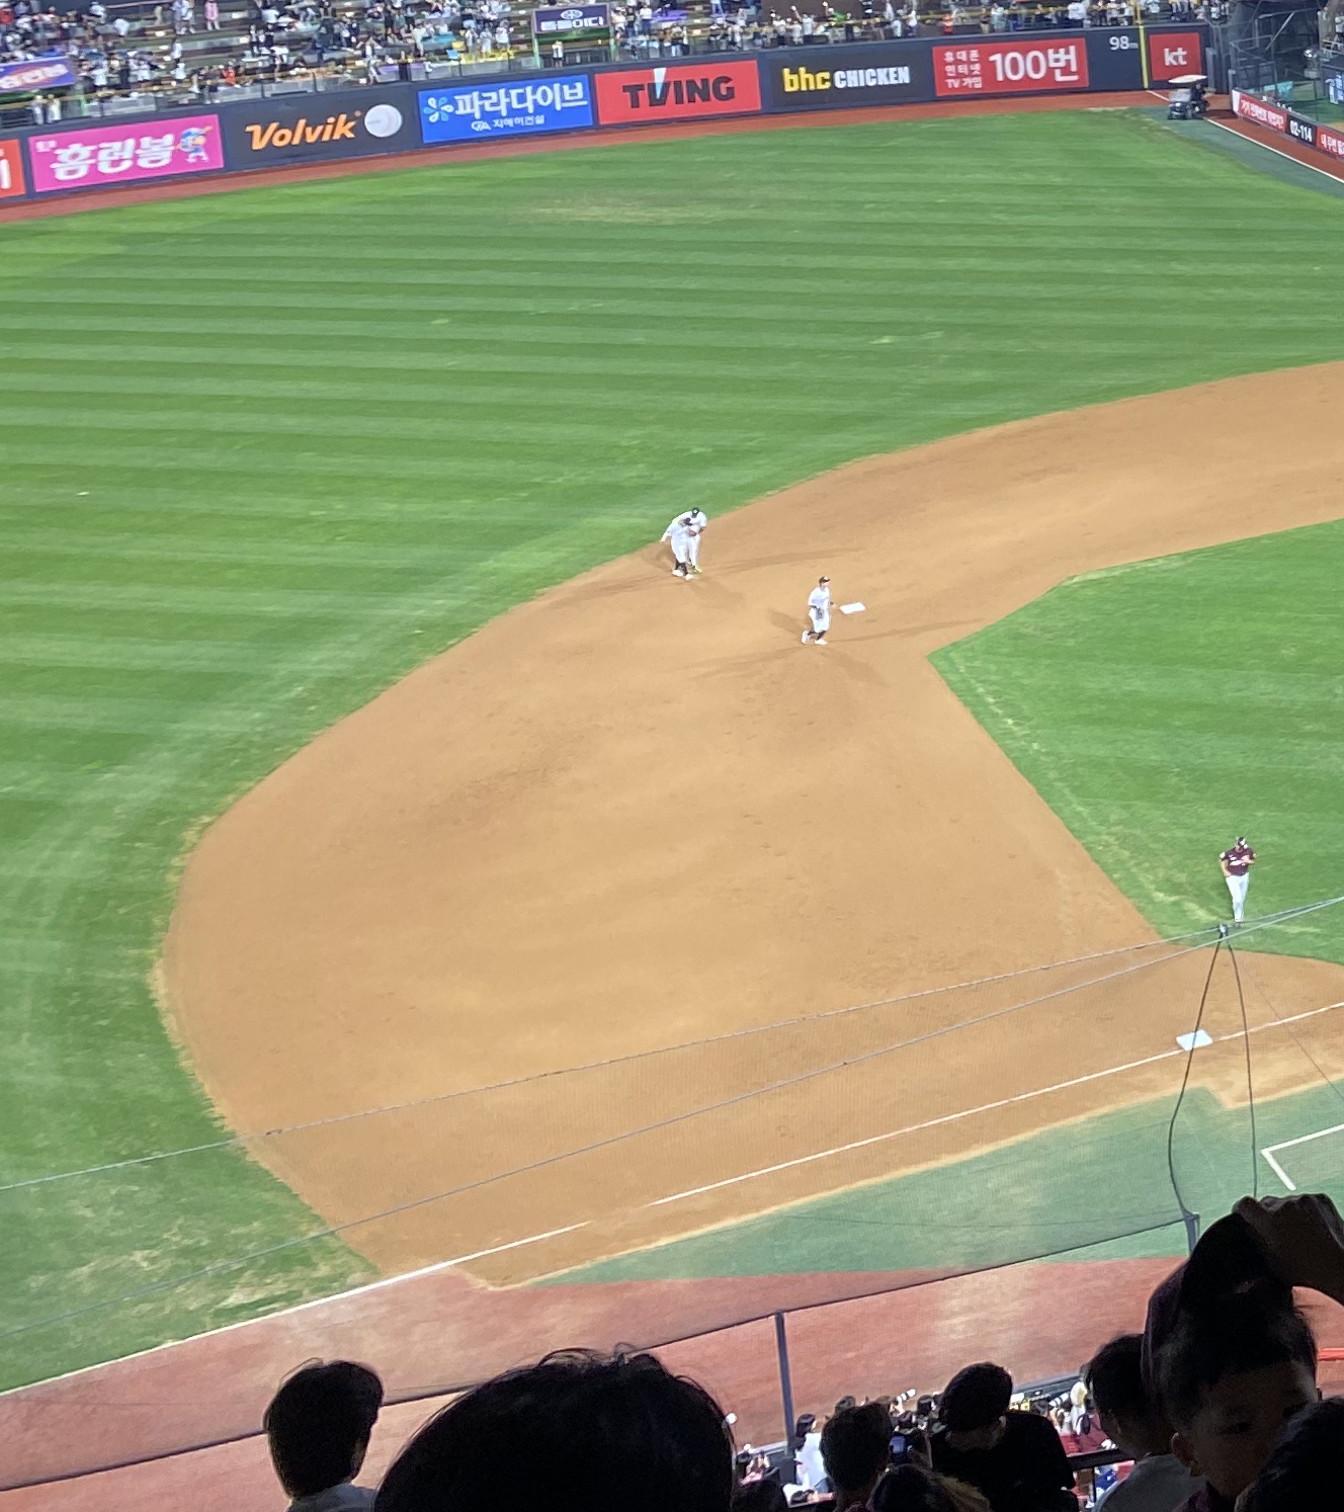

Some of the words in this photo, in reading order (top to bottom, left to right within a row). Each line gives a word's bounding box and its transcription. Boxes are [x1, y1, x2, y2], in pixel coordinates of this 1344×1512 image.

[944, 50, 979, 63] 휴대폰
[989, 44, 1079, 83] 100번
[1163, 47, 1188, 67] kt
[782, 67, 831, 93] bhc
[833, 66, 910, 89] CHICKEN
[944, 64, 981, 76] 인터넷
[622, 68, 736, 109] TVING
[946, 78, 961, 89] TV
[962, 77, 982, 89] 가입
[454, 81, 588, 120] 파라다이브
[245, 113, 356, 151] Volvik
[1289, 120, 1313, 143] 02-114
